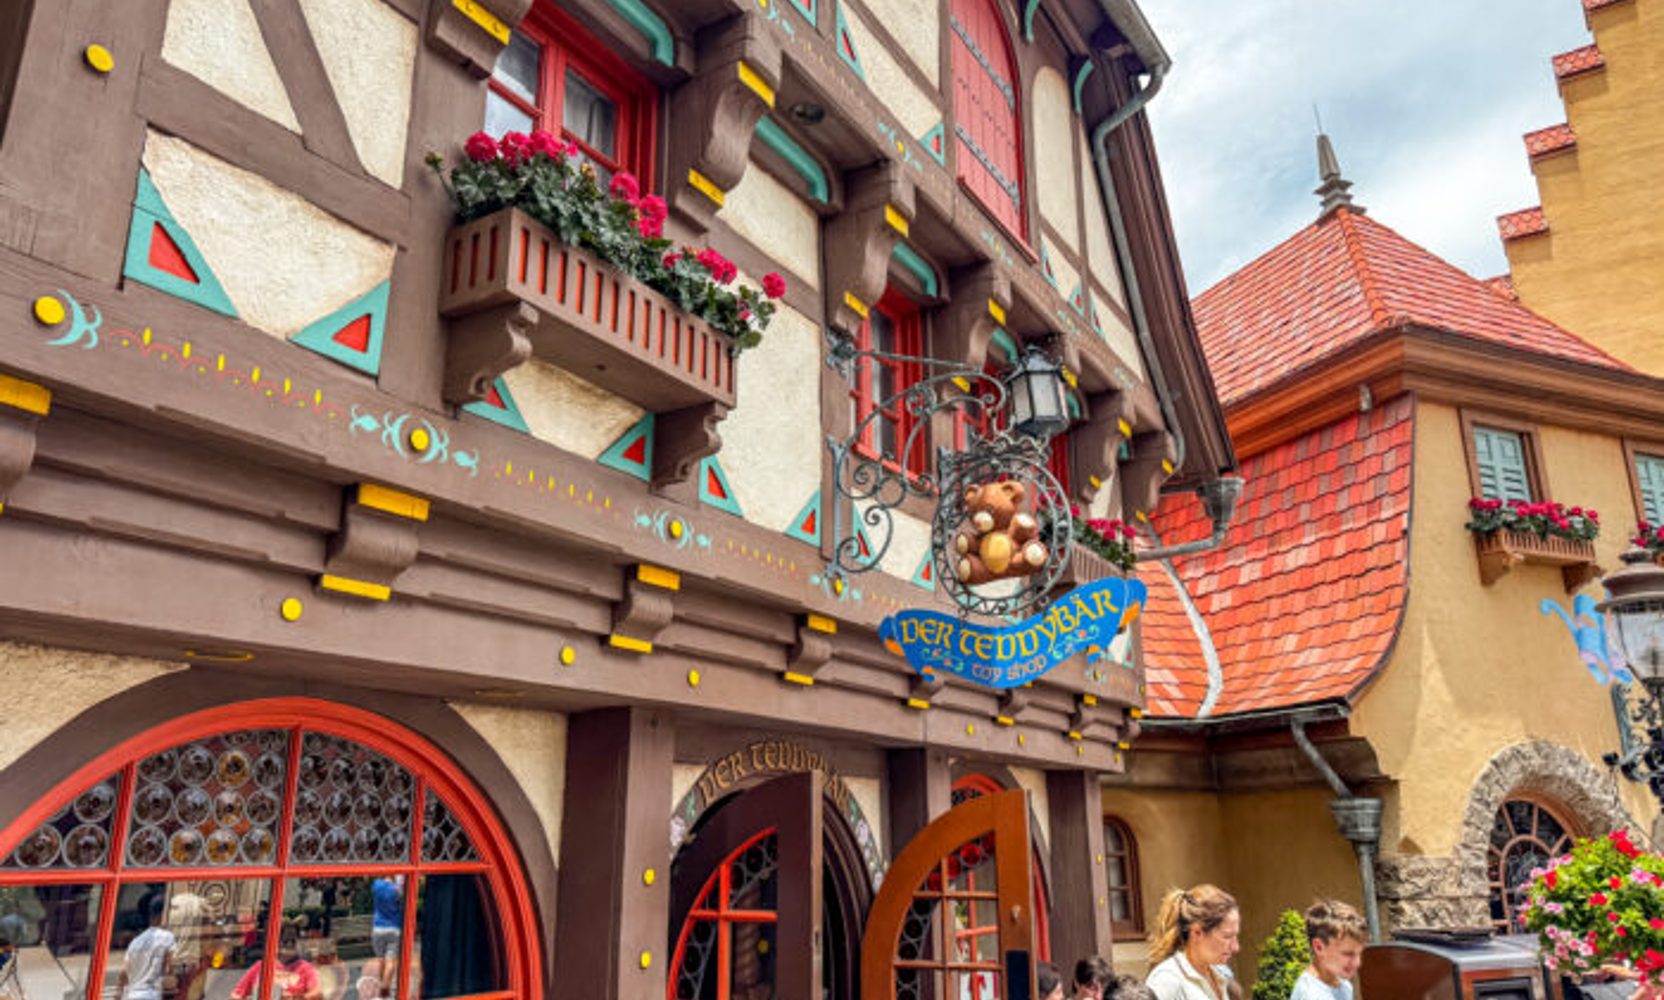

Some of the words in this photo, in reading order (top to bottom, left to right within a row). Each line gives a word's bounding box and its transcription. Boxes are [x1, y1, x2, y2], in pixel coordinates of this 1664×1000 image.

[900, 617, 953, 648] DER
[958, 588, 1118, 660] TEDDYBÄR
[972, 662, 1003, 683] toy
[1007, 654, 1047, 682] shop
[700, 752, 746, 806] DER
